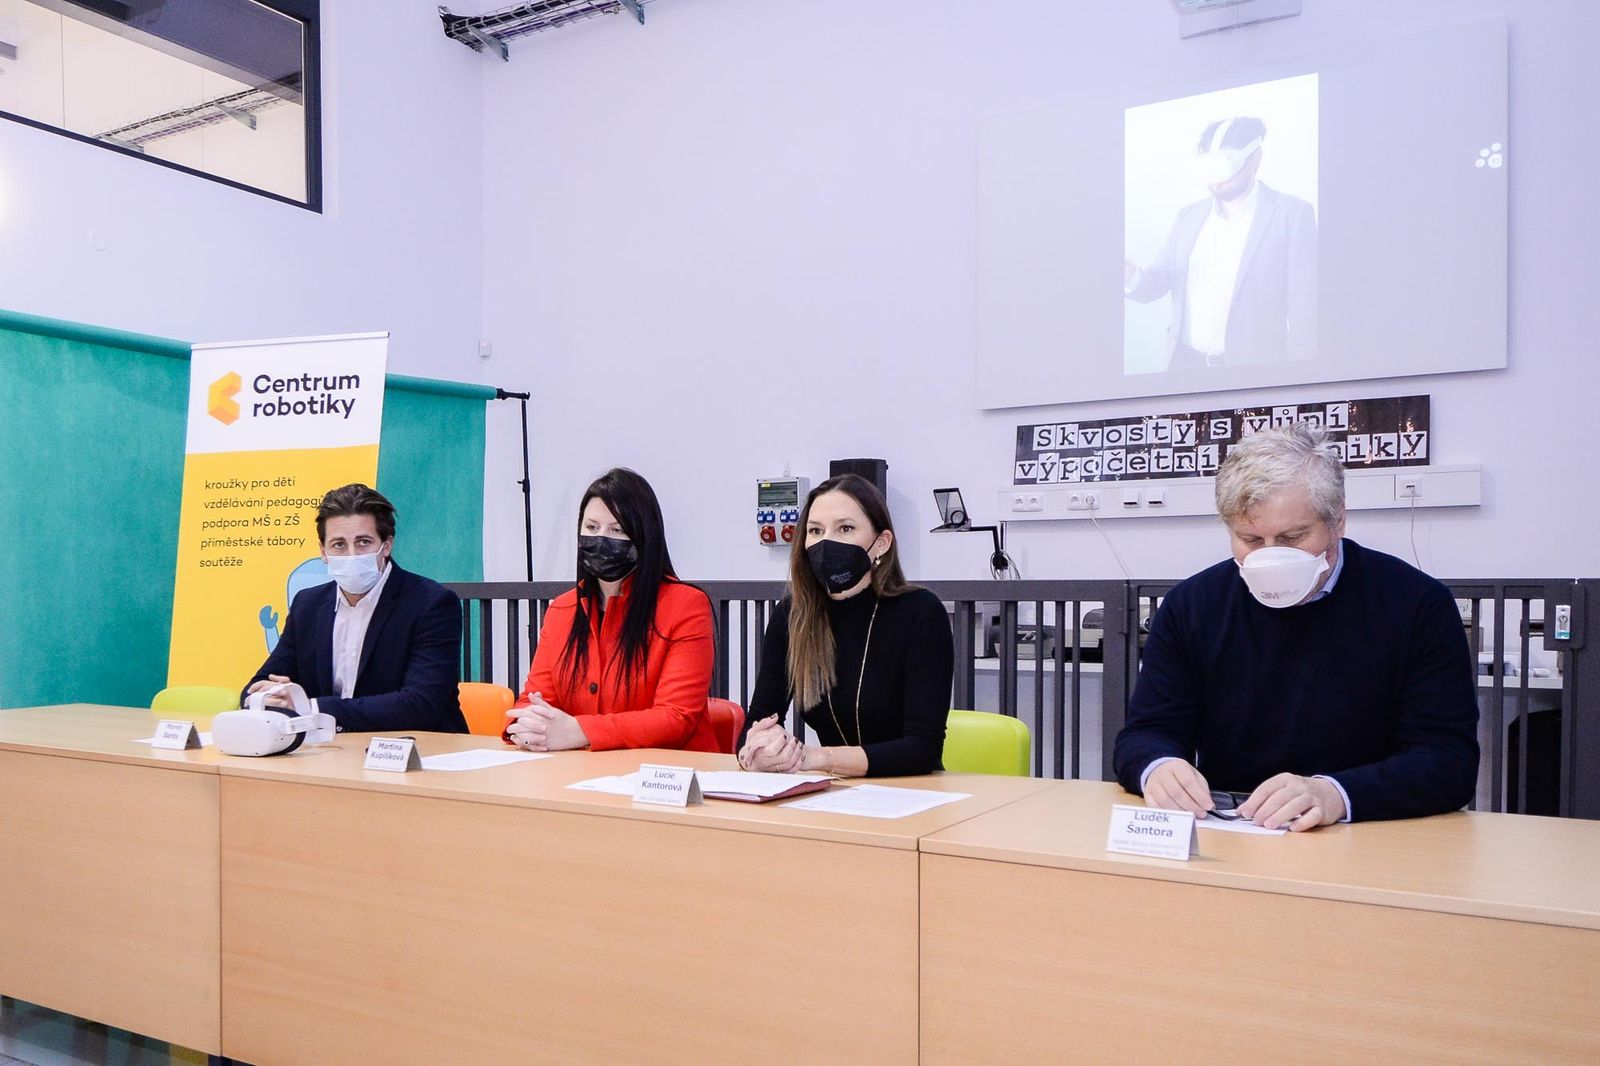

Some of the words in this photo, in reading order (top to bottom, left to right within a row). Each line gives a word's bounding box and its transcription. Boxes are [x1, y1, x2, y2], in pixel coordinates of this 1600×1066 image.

[253, 373, 360, 394] Centrum
[253, 393, 356, 419] robotiky
[1036, 421, 1194, 448] Skvosty
[1212, 420, 1229, 436] s
[1018, 447, 1216, 482] výpočetní
[204, 478, 249, 491] kroužky
[251, 479, 270, 491] pro
[273, 477, 296, 487] děti
[203, 497, 264, 509] vzdělávání
[202, 518, 249, 531] podpora
[252, 514, 271, 527] MŠ
[274, 518, 281, 526] a
[284, 513, 300, 526] ZŠ
[200, 536, 264, 550] příměstské
[266, 536, 306, 548] tábory
[199, 557, 244, 568] soutěže
[654, 770, 676, 780] Lucie
[641, 780, 683, 792] Kantorová
[1134, 811, 1170, 823] Luděk
[1126, 821, 1174, 838] Šantora
